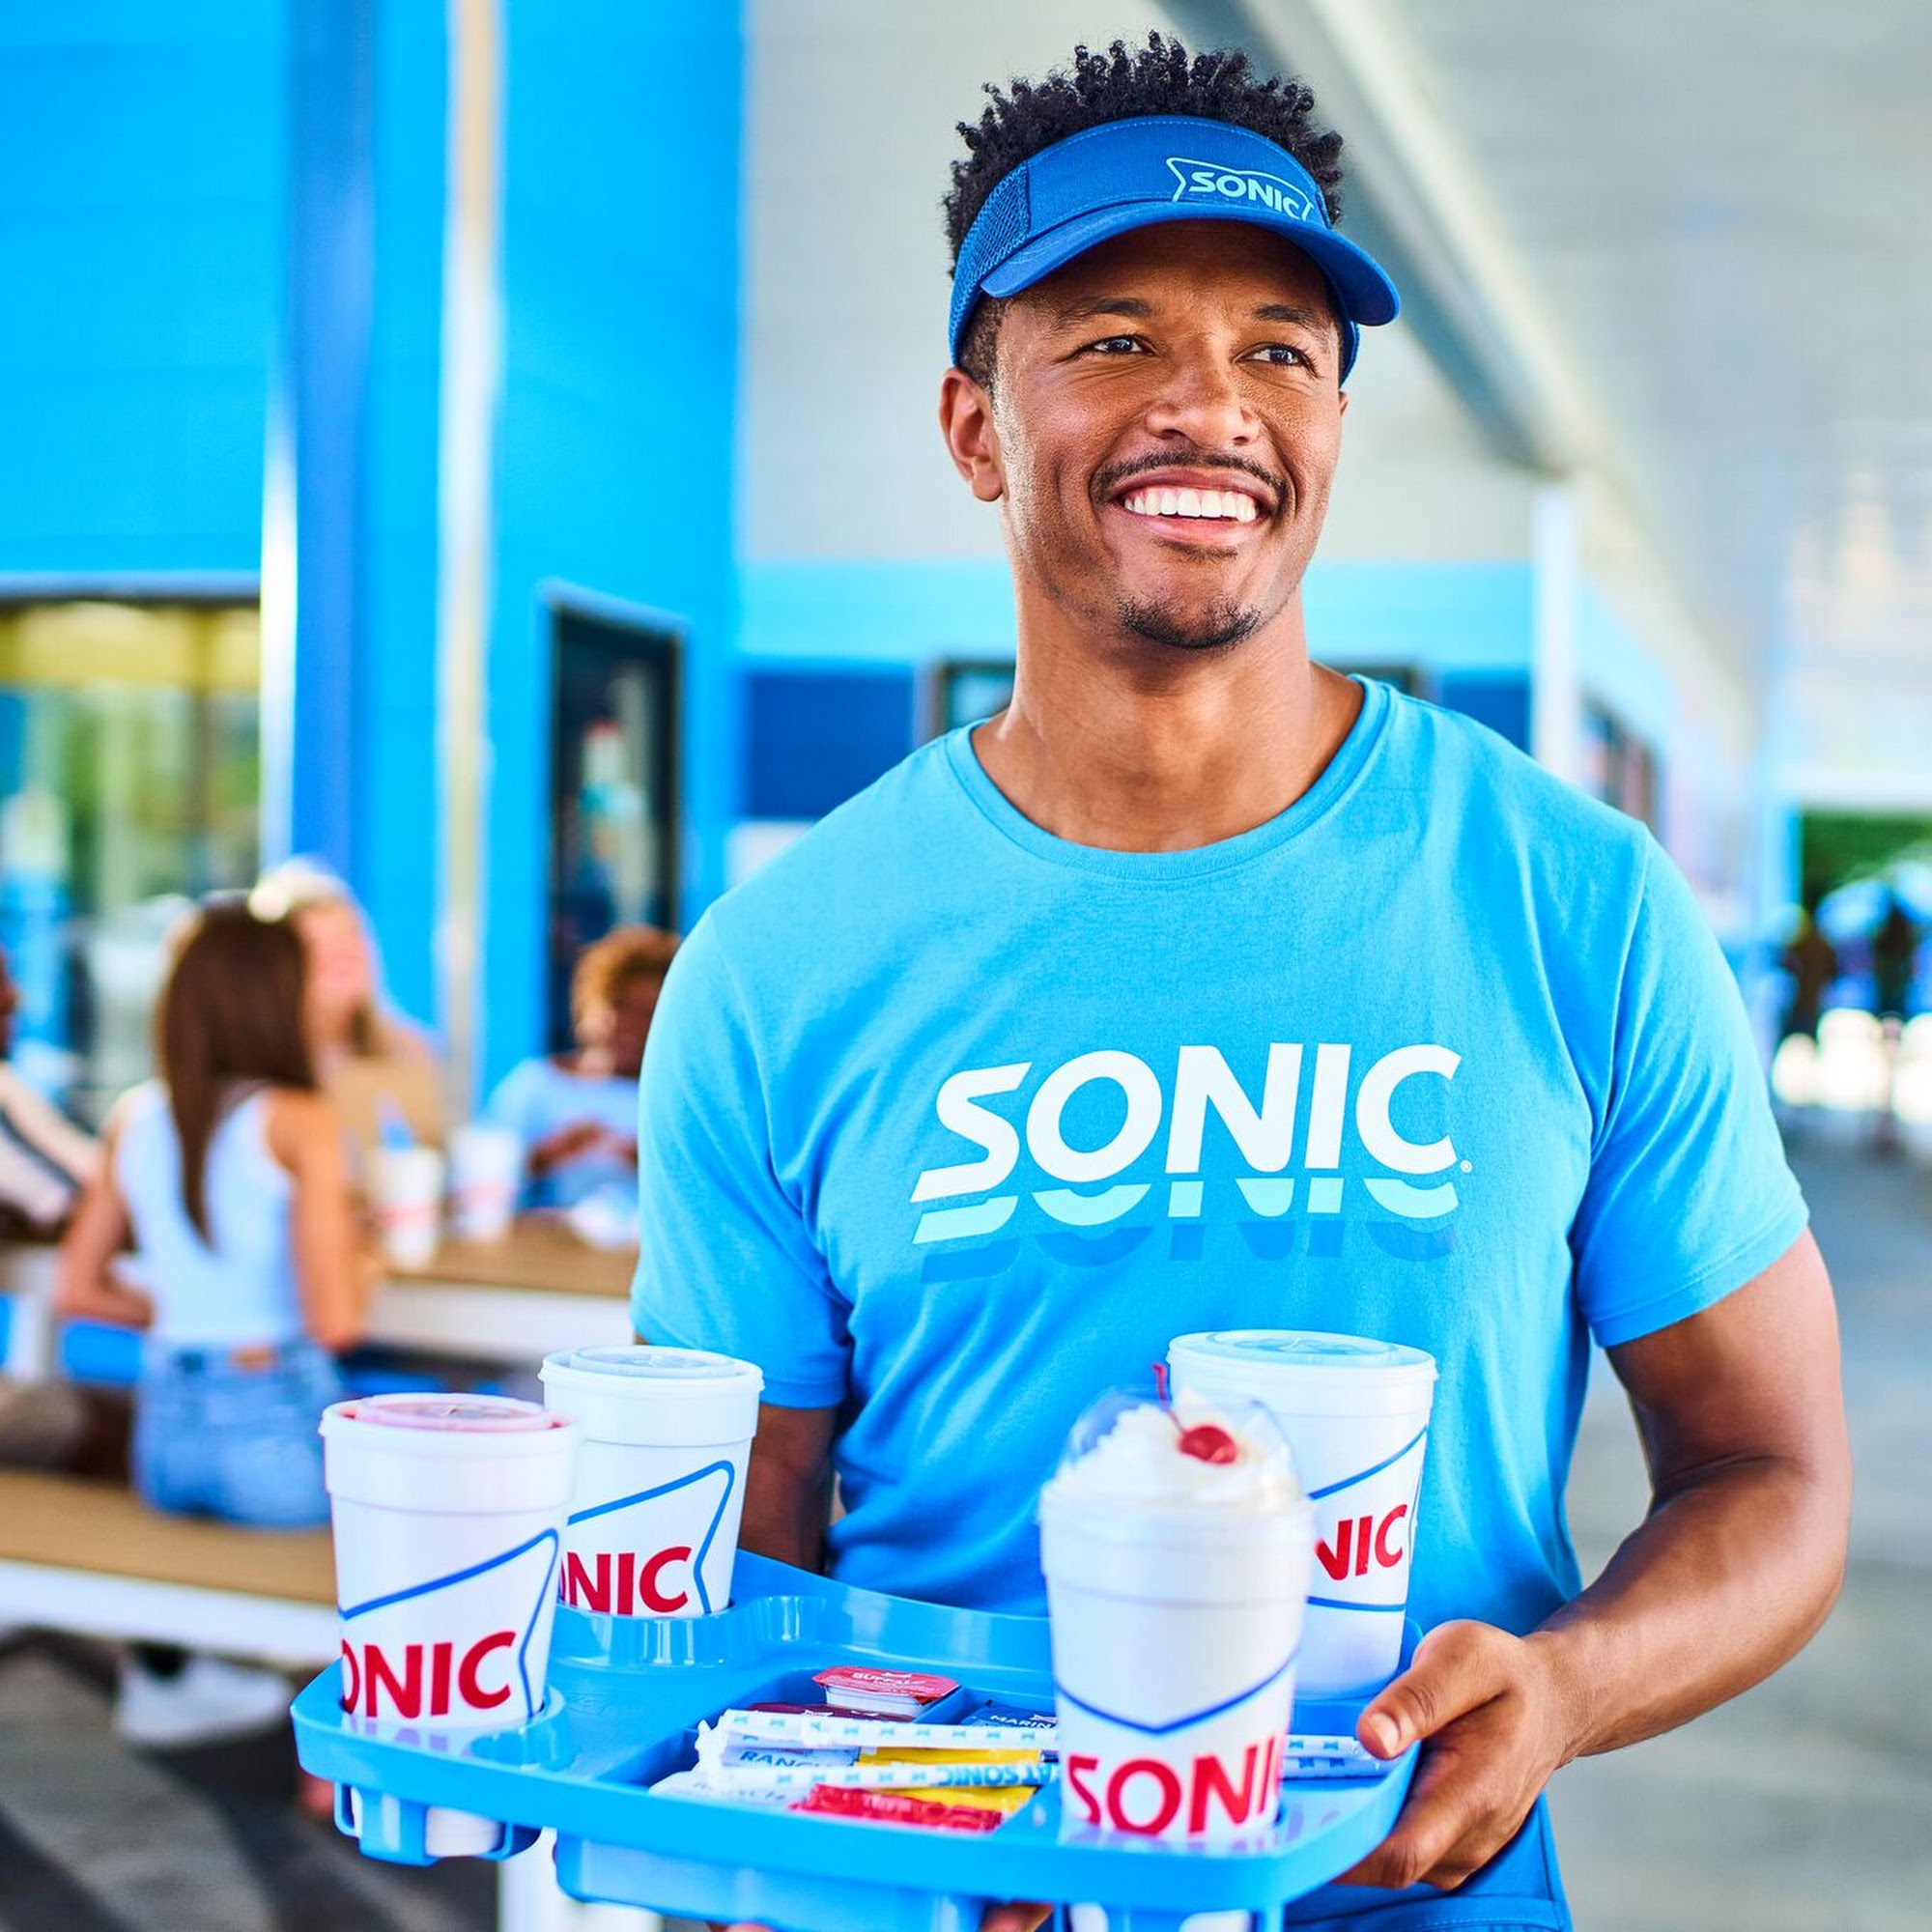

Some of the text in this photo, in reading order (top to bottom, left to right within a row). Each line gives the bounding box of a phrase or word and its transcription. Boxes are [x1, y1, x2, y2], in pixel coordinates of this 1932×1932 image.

[1188, 171, 1300, 220] SONIC
[910, 1042, 1462, 1204] SONIC
[560, 1547, 692, 1615] NIC
[740, 1750, 833, 1767] RAN
[1067, 1737, 1282, 1835] SONI
